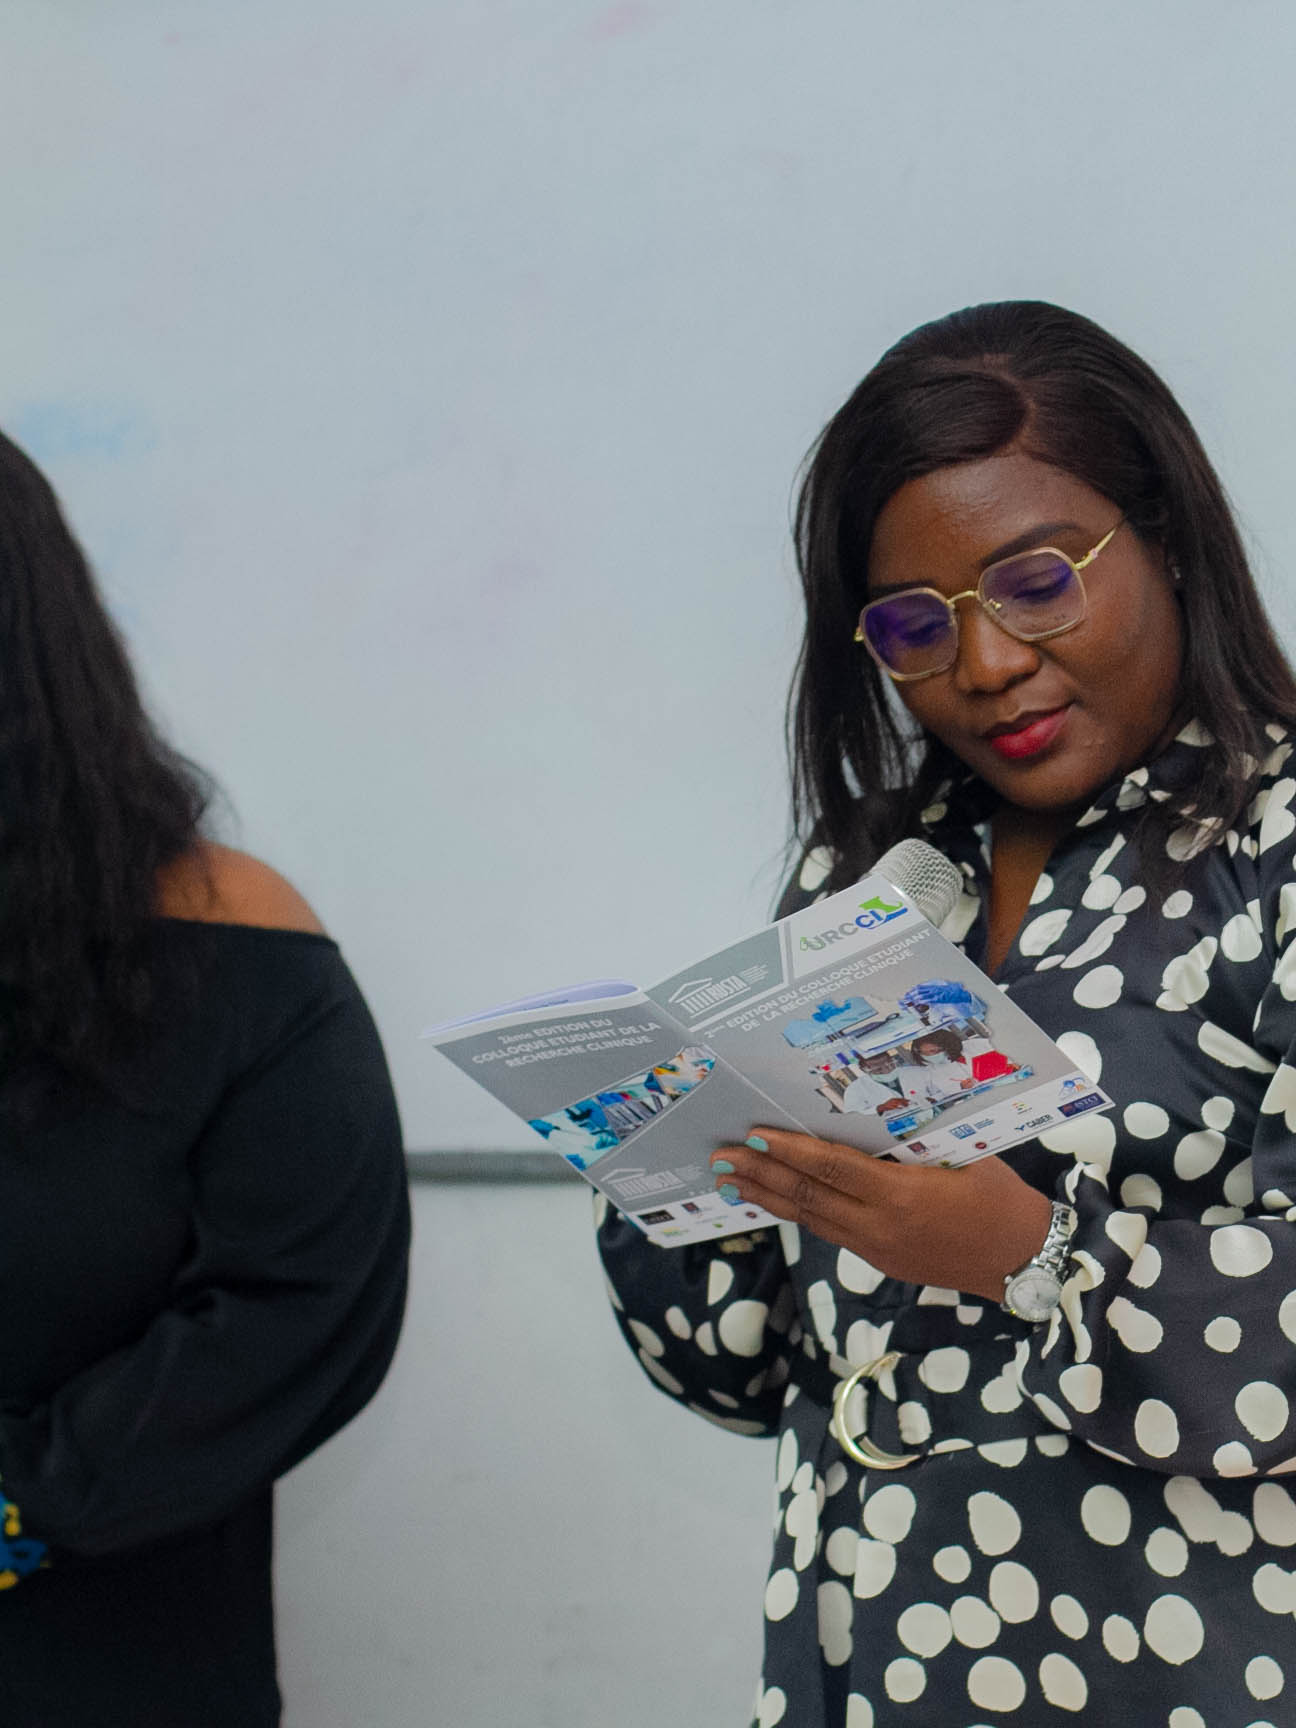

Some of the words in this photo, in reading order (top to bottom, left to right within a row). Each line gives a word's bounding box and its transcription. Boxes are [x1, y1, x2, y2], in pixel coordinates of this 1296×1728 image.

[726, 1000, 778, 1028] EDITION
[779, 990, 798, 1004] DU
[799, 960, 867, 994] COLLOQUE
[867, 928, 931, 962] ETUDIANT
[741, 1018, 760, 1032] DE
[763, 1009, 782, 1021] LA
[781, 976, 855, 1013] RECHERCHE
[854, 949, 914, 979] CLINIQUE
[472, 1038, 549, 1065] COLLOQUE
[548, 1028, 617, 1046] ETUDIANT
[618, 1025, 641, 1036] DE
[639, 1021, 662, 1032] LA
[533, 1021, 590, 1036] EDITION
[590, 1018, 613, 1028] DU
[505, 1045, 587, 1068] RECHERCHE
[586, 1034, 654, 1052] CLINIQUE
